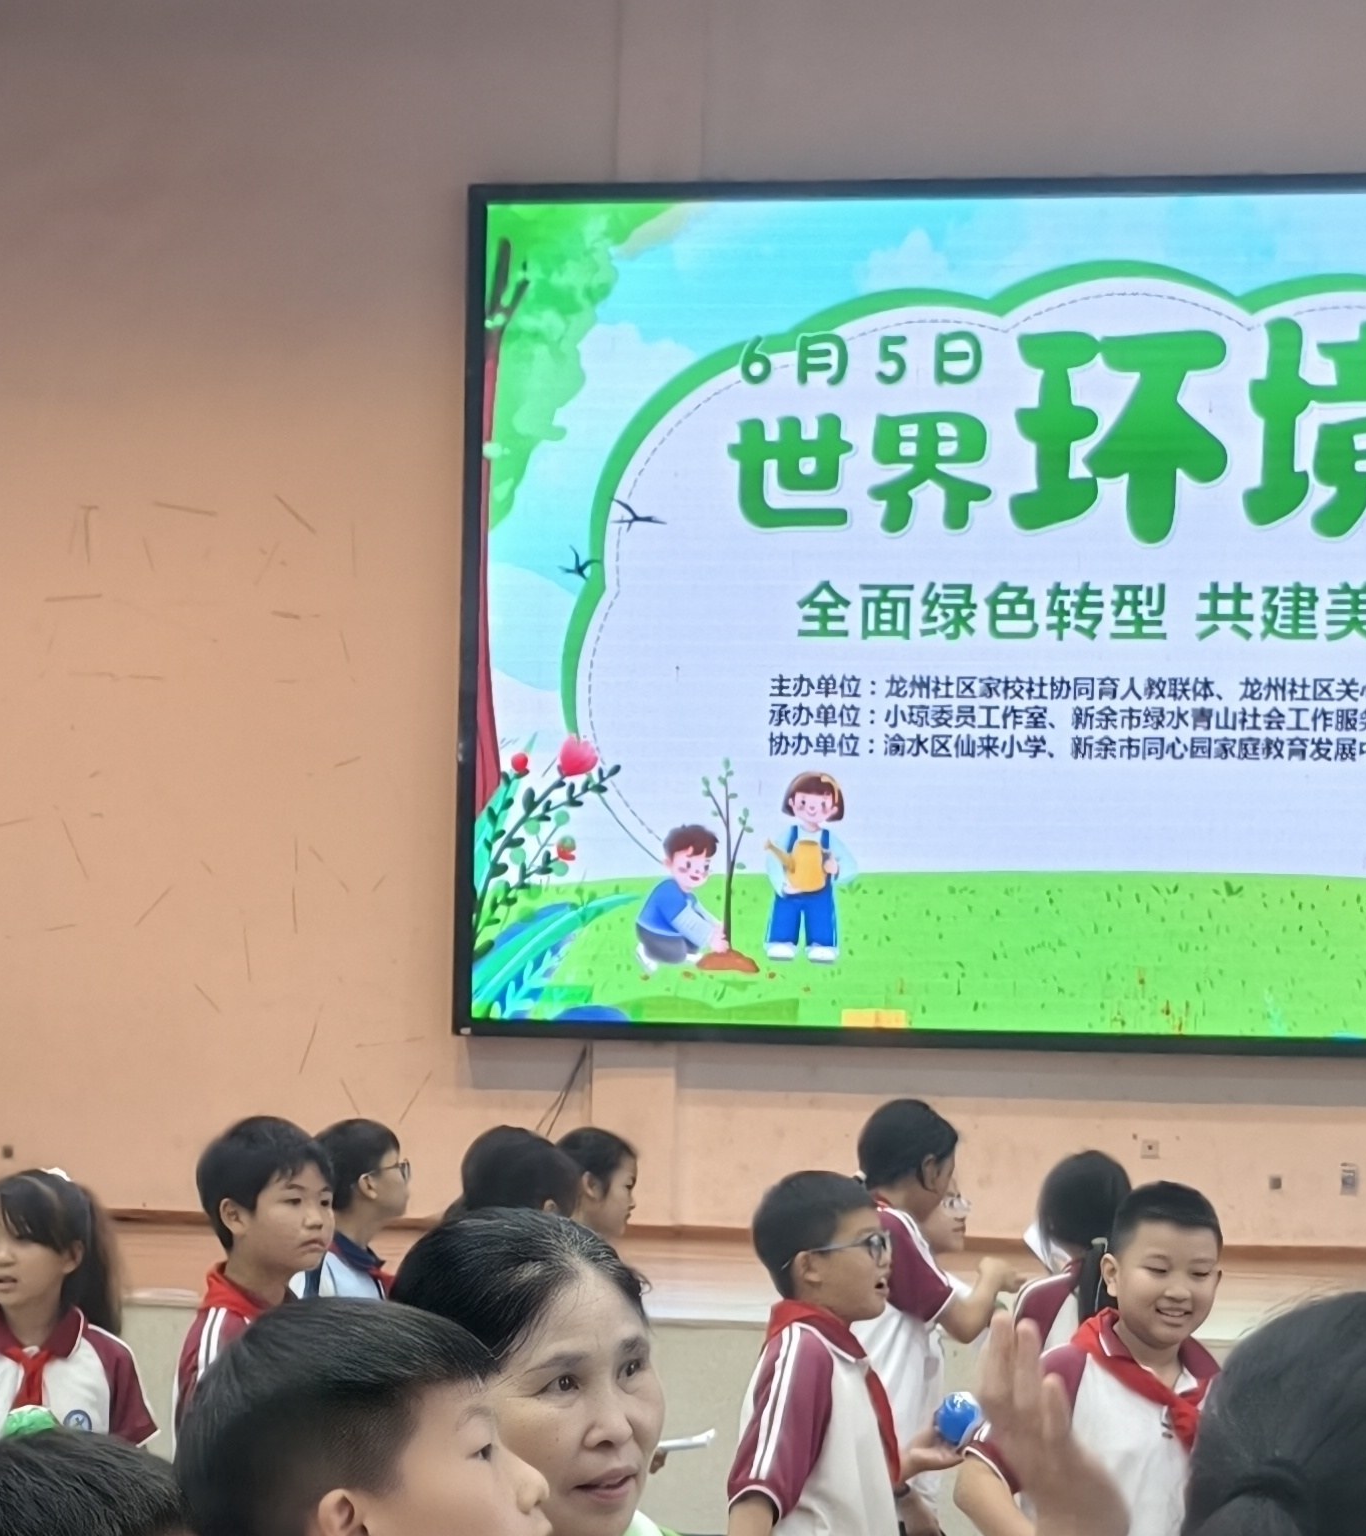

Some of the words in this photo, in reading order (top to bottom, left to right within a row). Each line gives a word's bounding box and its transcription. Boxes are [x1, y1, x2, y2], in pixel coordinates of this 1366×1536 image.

[740, 331, 982, 385] 6月5日
[796, 579, 1168, 642] 全面绿色转型
